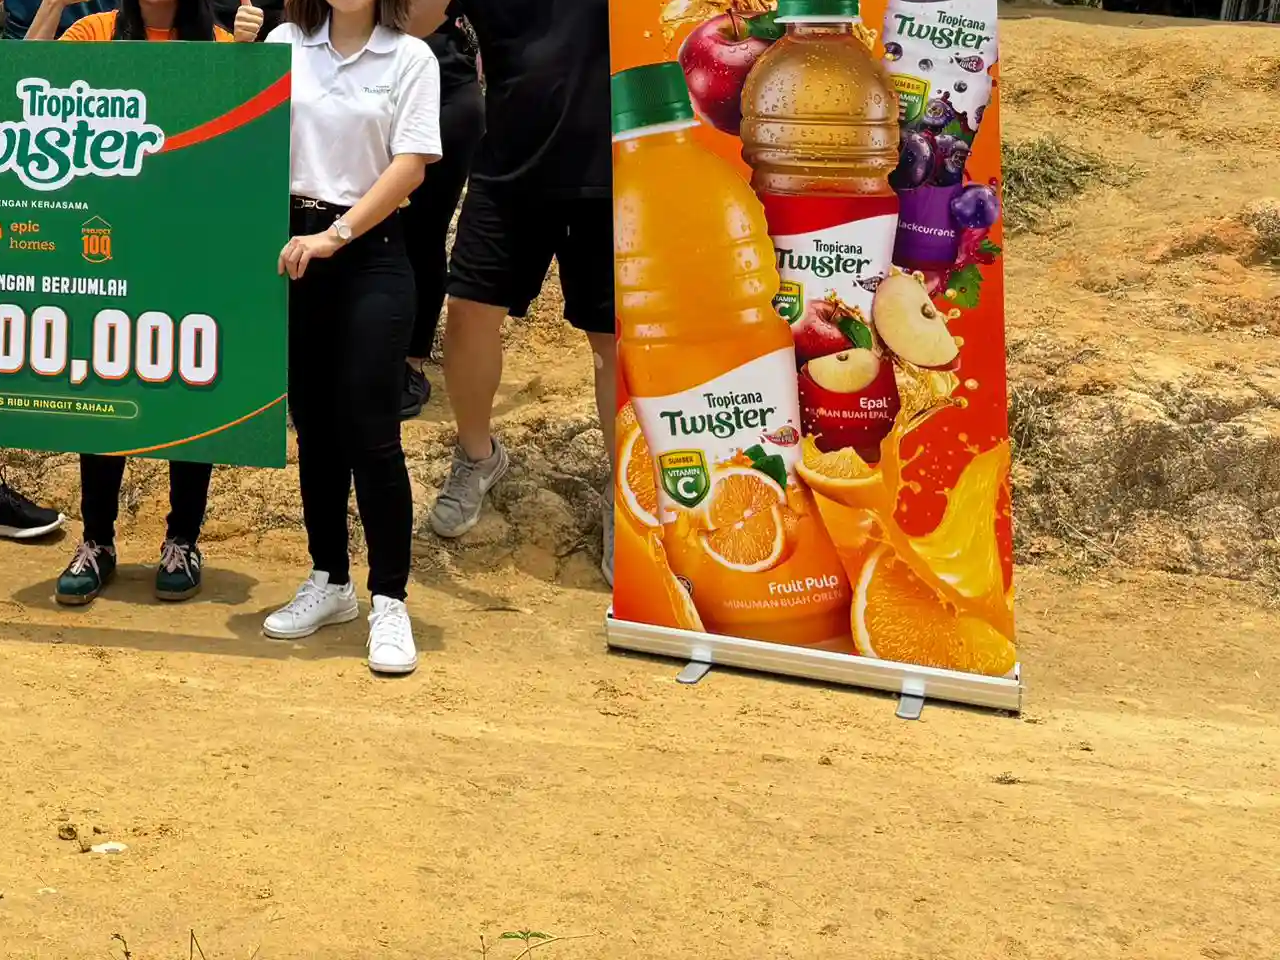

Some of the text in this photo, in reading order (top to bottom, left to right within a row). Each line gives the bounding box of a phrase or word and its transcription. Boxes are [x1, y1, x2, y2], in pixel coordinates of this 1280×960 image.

[937, 10, 986, 31] Tropicana
[894, 13, 991, 49] Twister
[23, 85, 139, 122] Tropicana
[31, 200, 89, 210] KERJASAMA
[10, 220, 40, 234] epic
[898, 219, 955, 238] lackcurrant
[9, 237, 56, 251] homes
[81, 235, 111, 257] 100
[813, 239, 863, 255] Tropicana
[775, 248, 870, 278] Twister
[41, 276, 128, 297] BERJUMLAH
[775, 295, 797, 303] TAMIN
[7, 398, 30, 407] RIBU
[33, 400, 72, 410] RINGGIT
[75, 402, 115, 413] SAHAJA
[703, 391, 763, 409] Tropicana
[859, 396, 888, 410] Epal
[659, 406, 776, 439] Twister
[841, 410, 867, 419] BUAH
[668, 455, 694, 465] SUMBER
[667, 468, 701, 478] VITAMIN
[677, 476, 698, 499] C
[768, 574, 839, 596] Fruit Pulp
[724, 590, 842, 611] MINUMAN BUAH OREN
